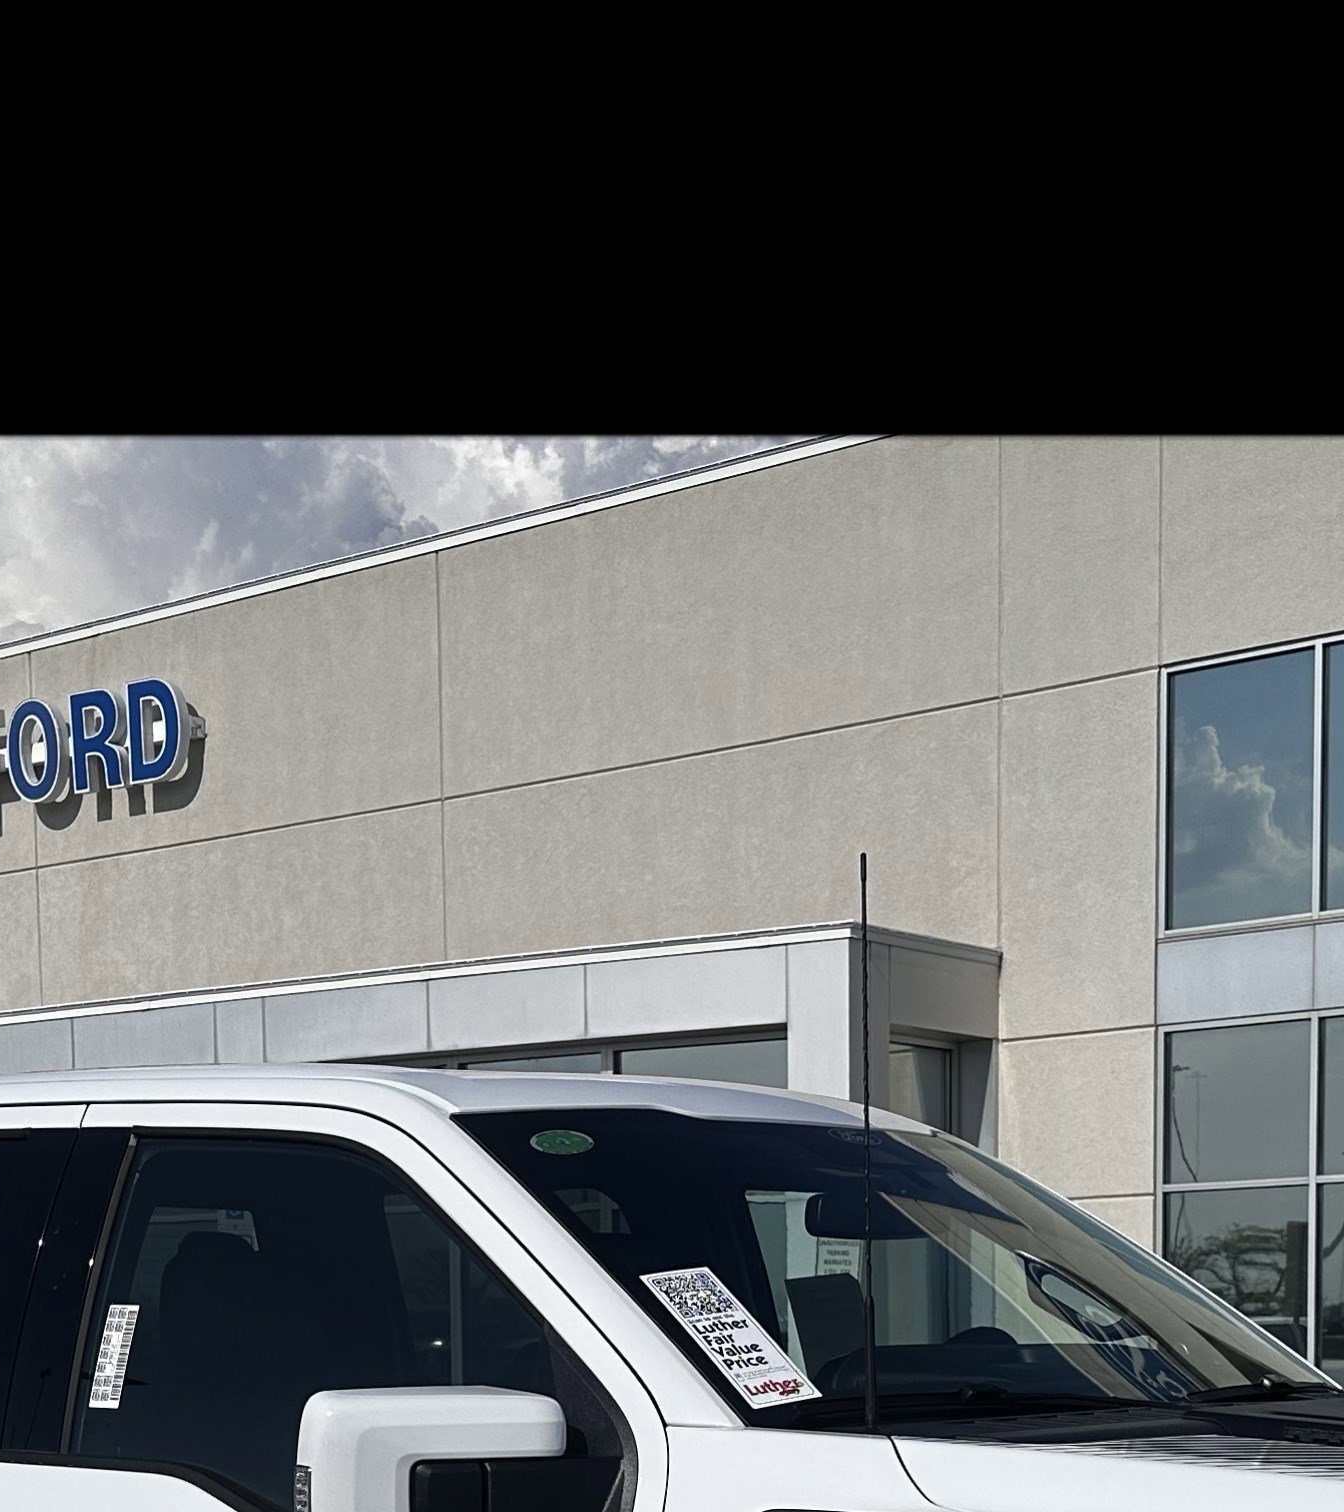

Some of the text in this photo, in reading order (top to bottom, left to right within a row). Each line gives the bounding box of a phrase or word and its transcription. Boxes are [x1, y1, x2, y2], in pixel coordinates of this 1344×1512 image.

[692, 1319, 750, 1335] Luther
[701, 1331, 735, 1347] Fair
[710, 1343, 763, 1358] Value
[722, 1354, 769, 1371] Price
[743, 1378, 799, 1397] Luther
